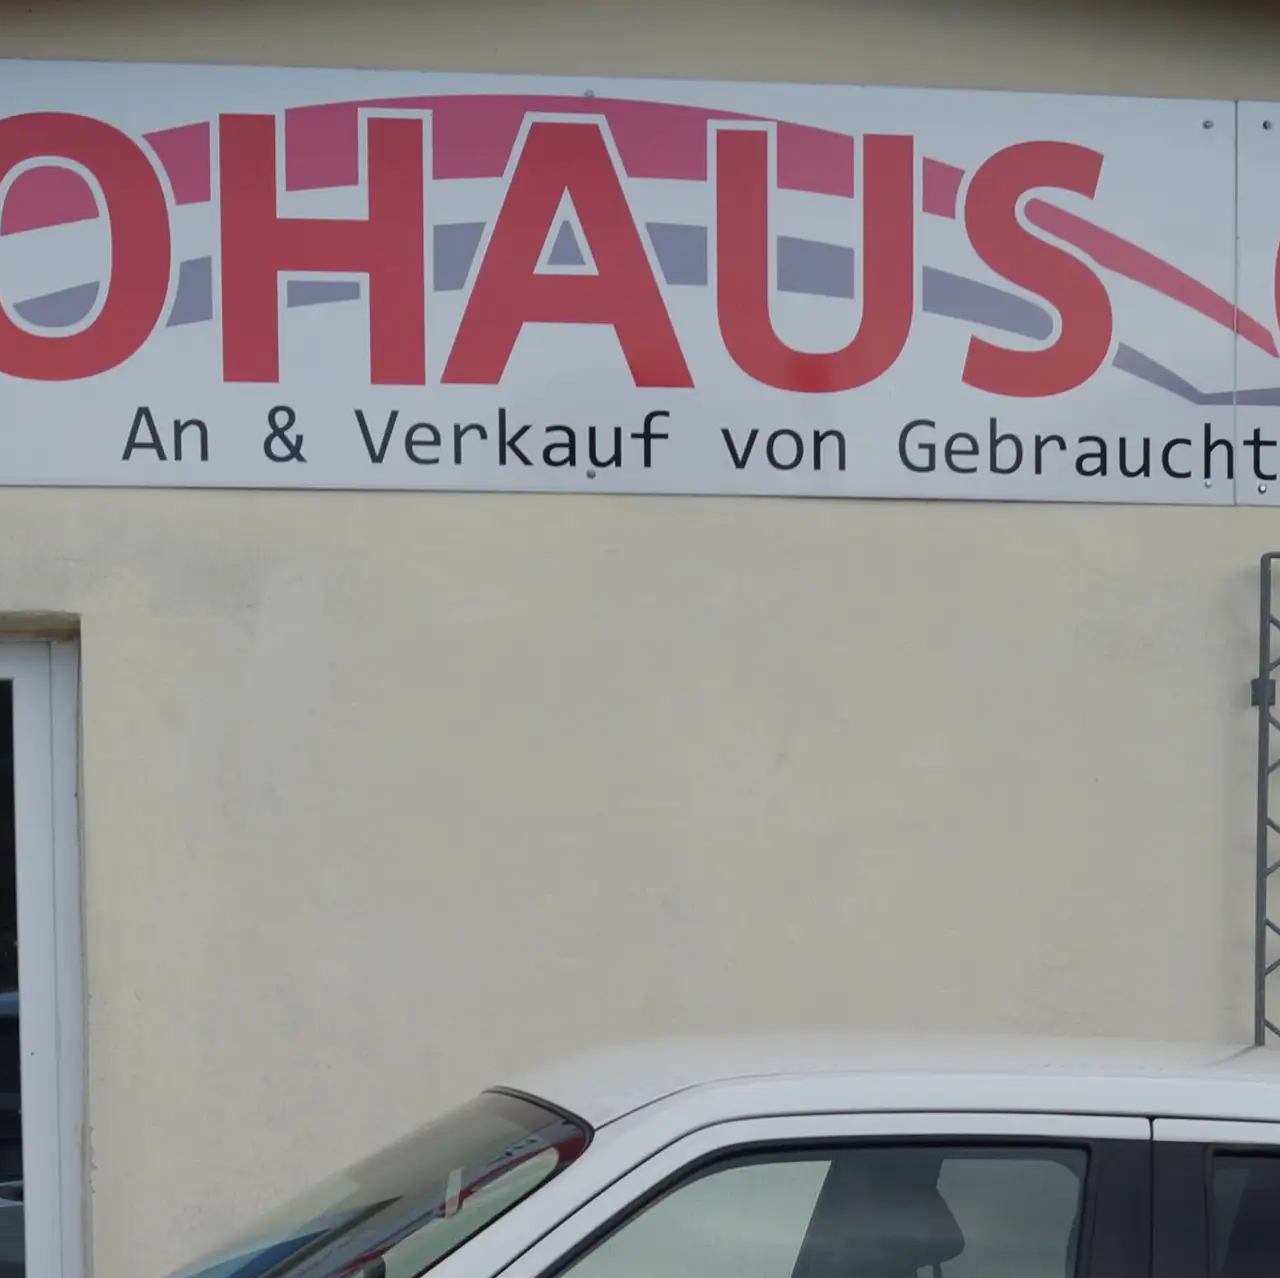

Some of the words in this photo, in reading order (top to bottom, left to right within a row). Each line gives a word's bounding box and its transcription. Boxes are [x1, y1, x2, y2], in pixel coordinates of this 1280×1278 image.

[121, 406, 209, 463] An
[263, 405, 308, 464] &
[354, 408, 671, 470] Verkauf
[721, 427, 847, 472] von
